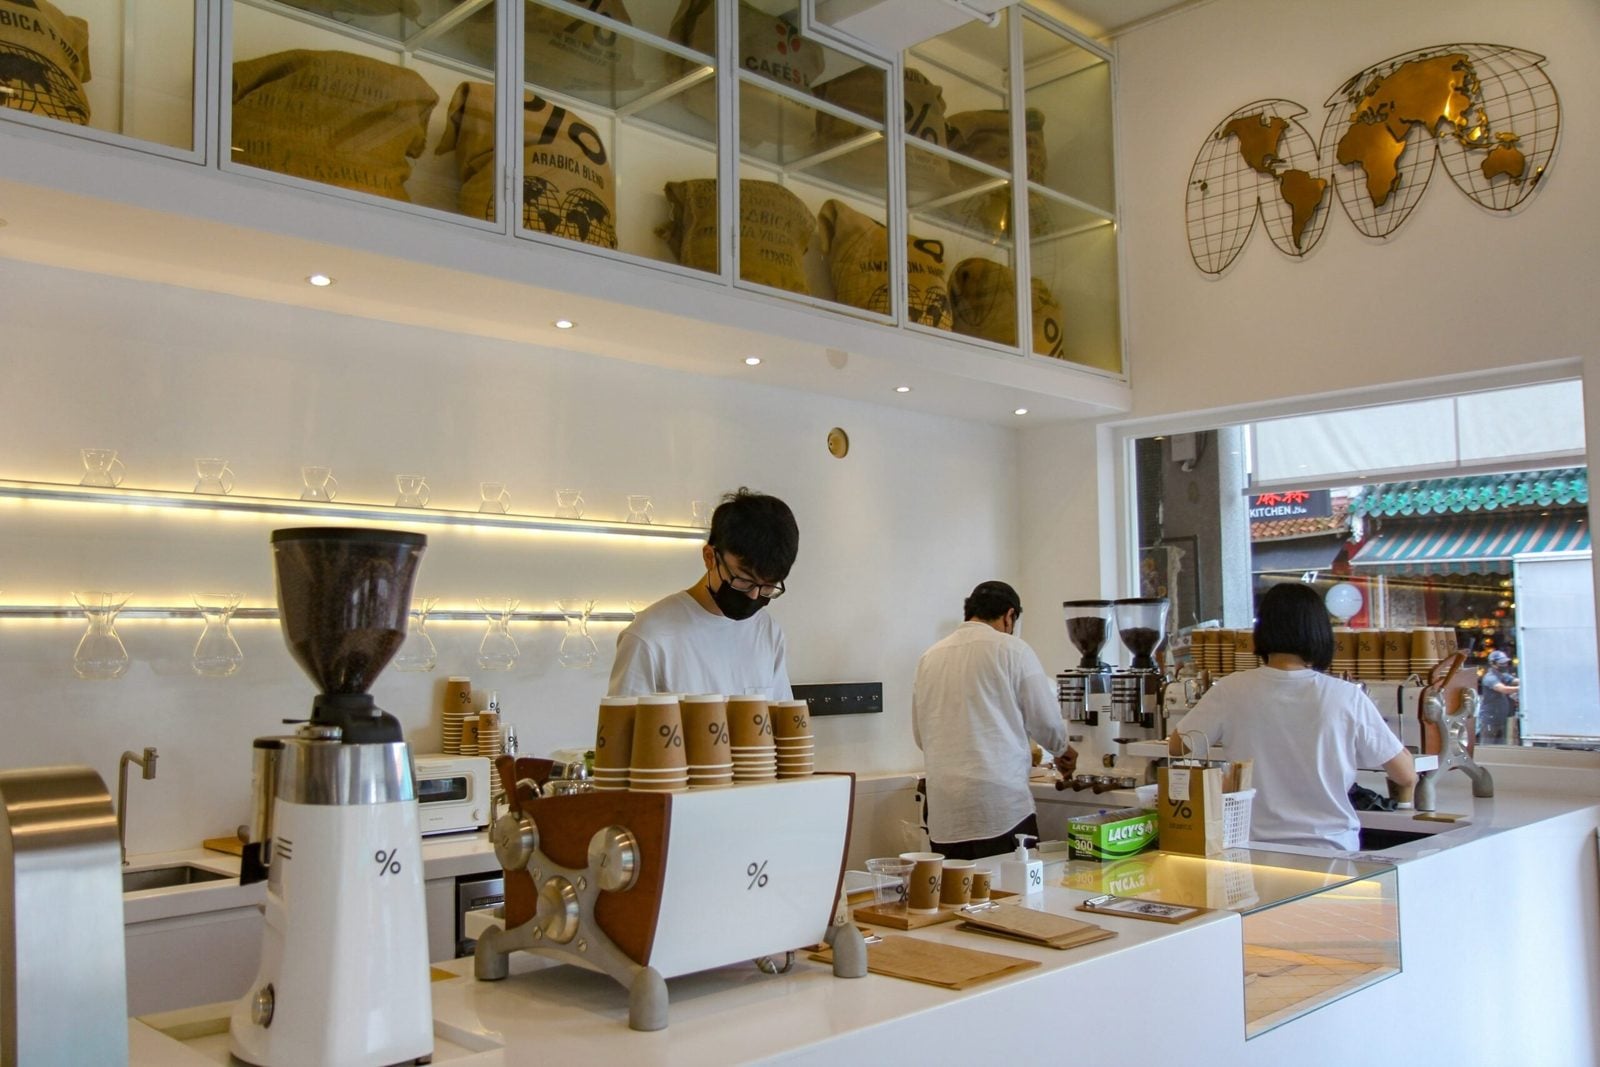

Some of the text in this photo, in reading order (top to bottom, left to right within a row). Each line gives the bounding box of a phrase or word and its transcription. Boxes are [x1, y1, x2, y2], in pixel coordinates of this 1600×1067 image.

[532, 151, 581, 175] ARABICA
[1249, 506, 1291, 518] KITCHEN
[1301, 571, 1319, 584] 47
[1108, 822, 1145, 842] LACY'S
[1074, 840, 1094, 851] 300
